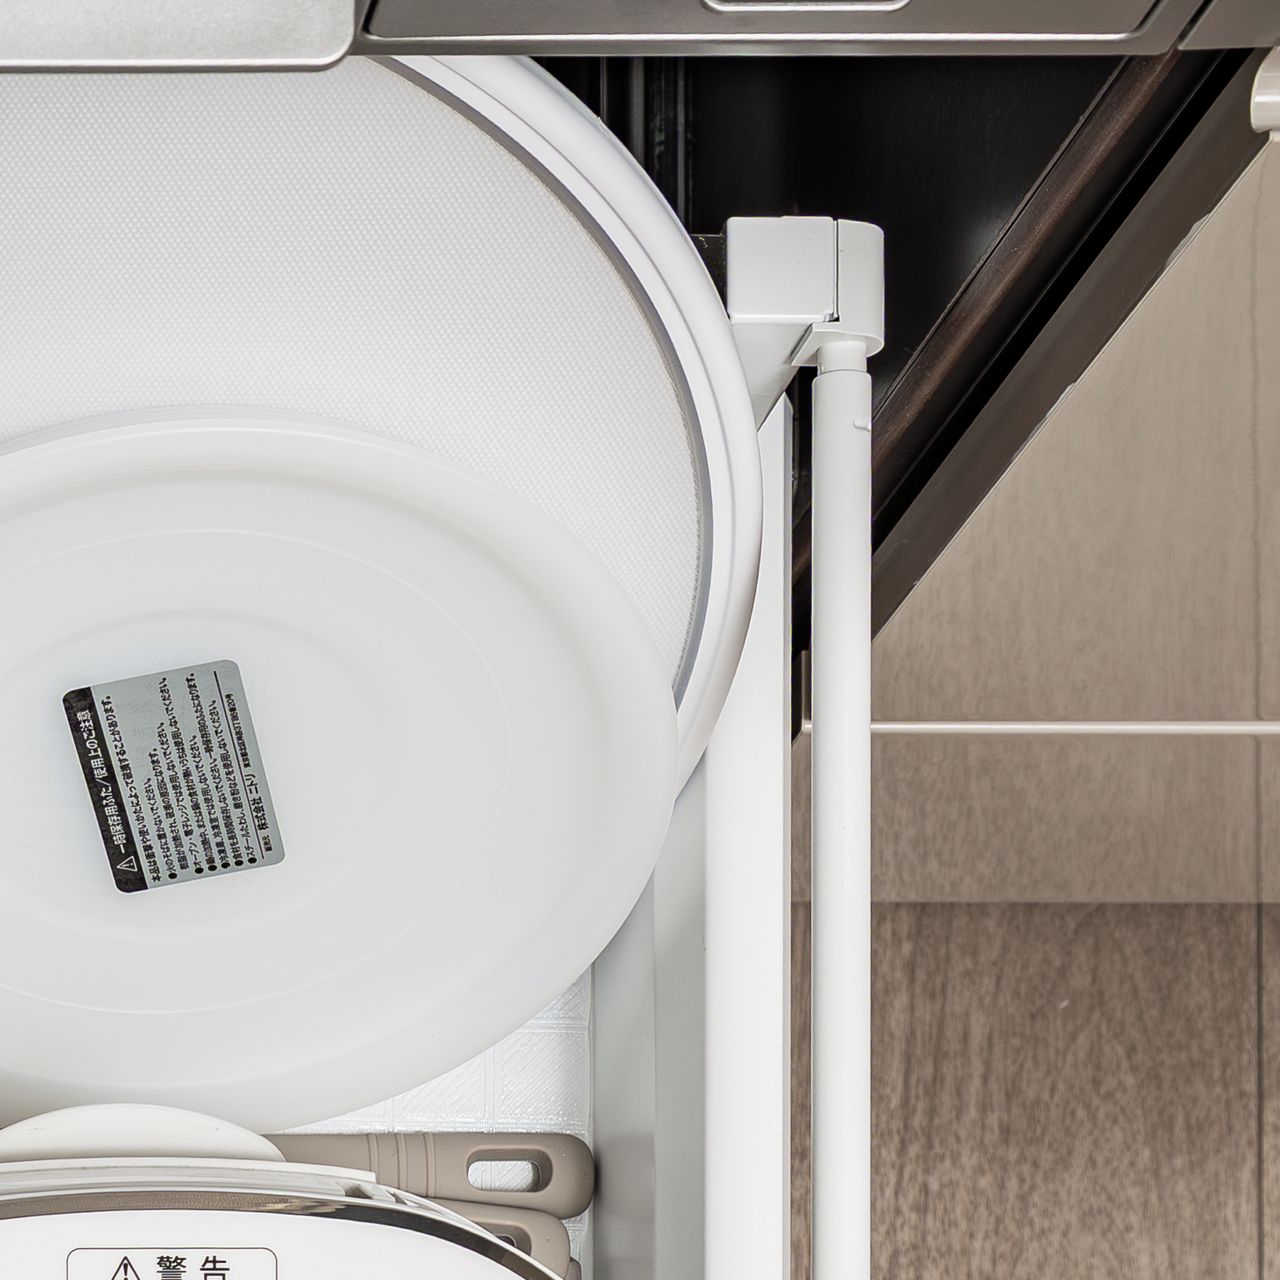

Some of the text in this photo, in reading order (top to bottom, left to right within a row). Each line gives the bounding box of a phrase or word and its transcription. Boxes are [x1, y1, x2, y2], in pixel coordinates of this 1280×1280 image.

[244, 772, 259, 794] ニトリ
[250, 796, 269, 830] 株式会社
